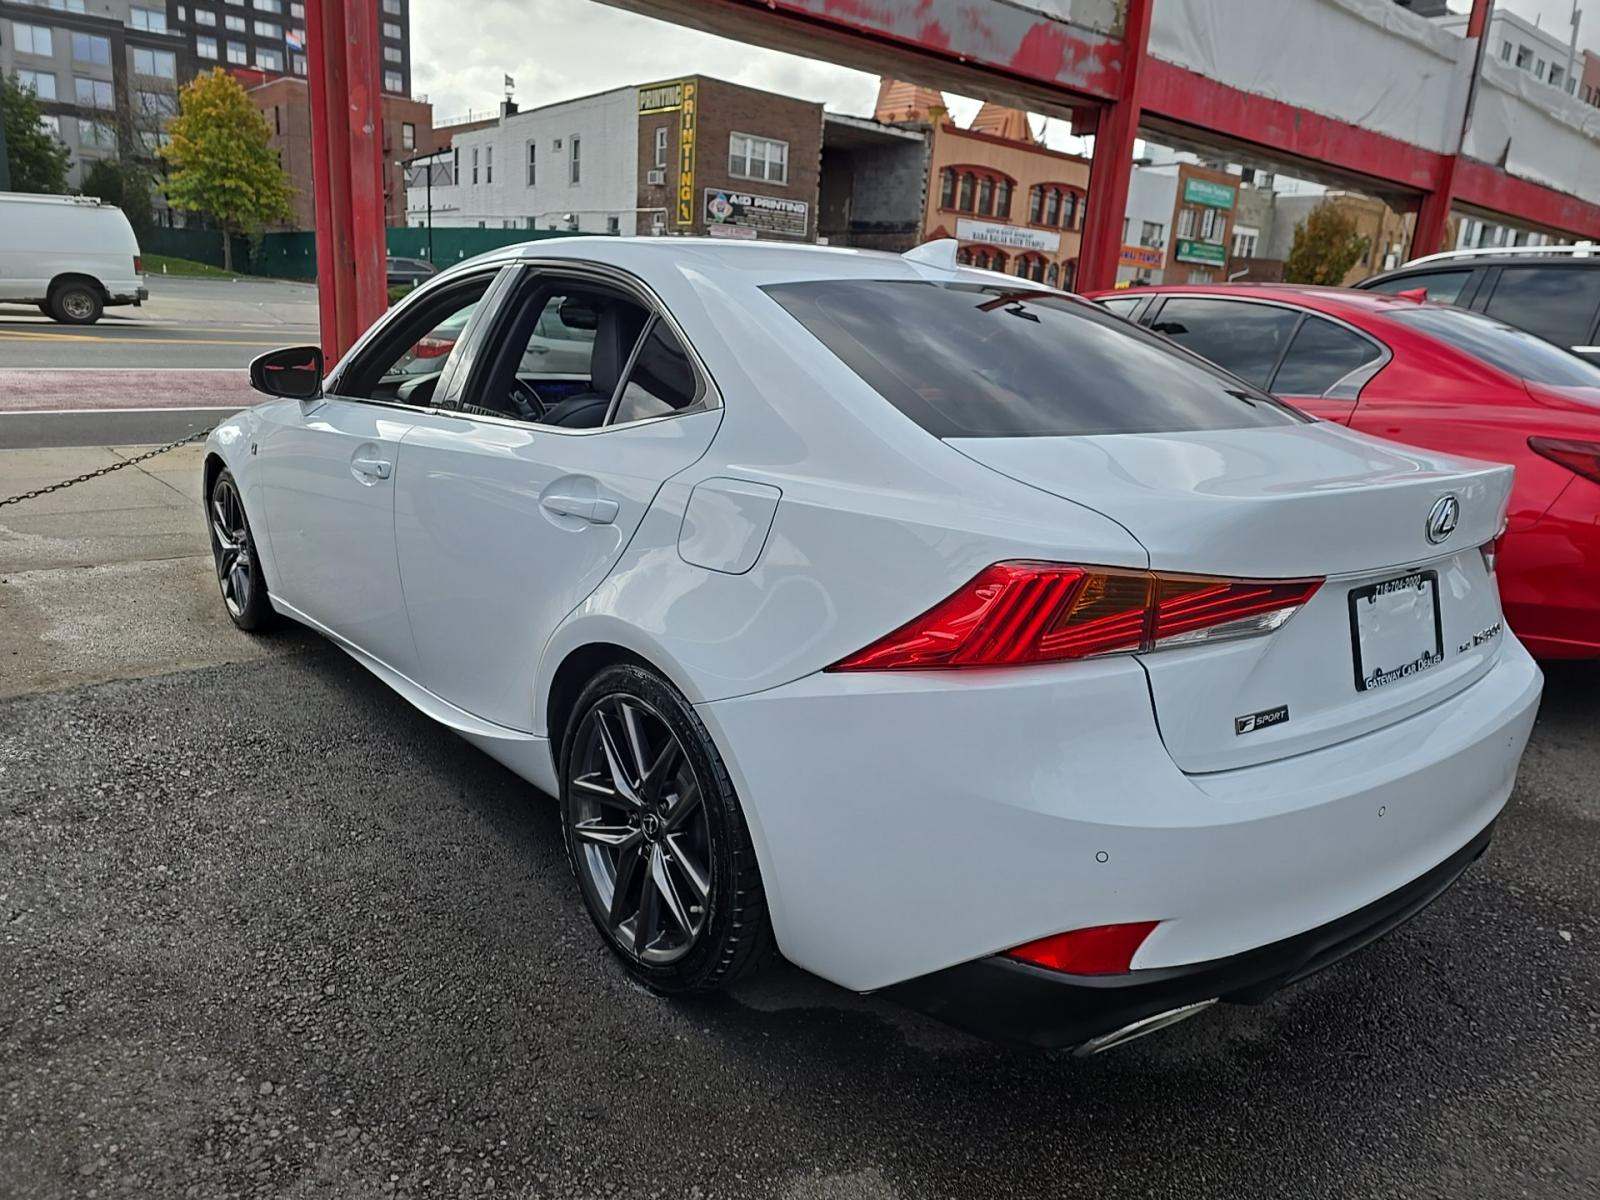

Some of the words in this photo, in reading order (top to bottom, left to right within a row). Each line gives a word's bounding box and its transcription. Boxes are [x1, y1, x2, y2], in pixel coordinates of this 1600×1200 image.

[640, 84, 681, 110] PRINTING
[681, 84, 695, 200] PRINTING
[754, 197, 805, 213] PRINTING
[1366, 671, 1401, 690] GATEWAY
[1402, 664, 1417, 678] CAR
[1418, 655, 1441, 671] DEALER
[1256, 710, 1286, 726] SPORT
